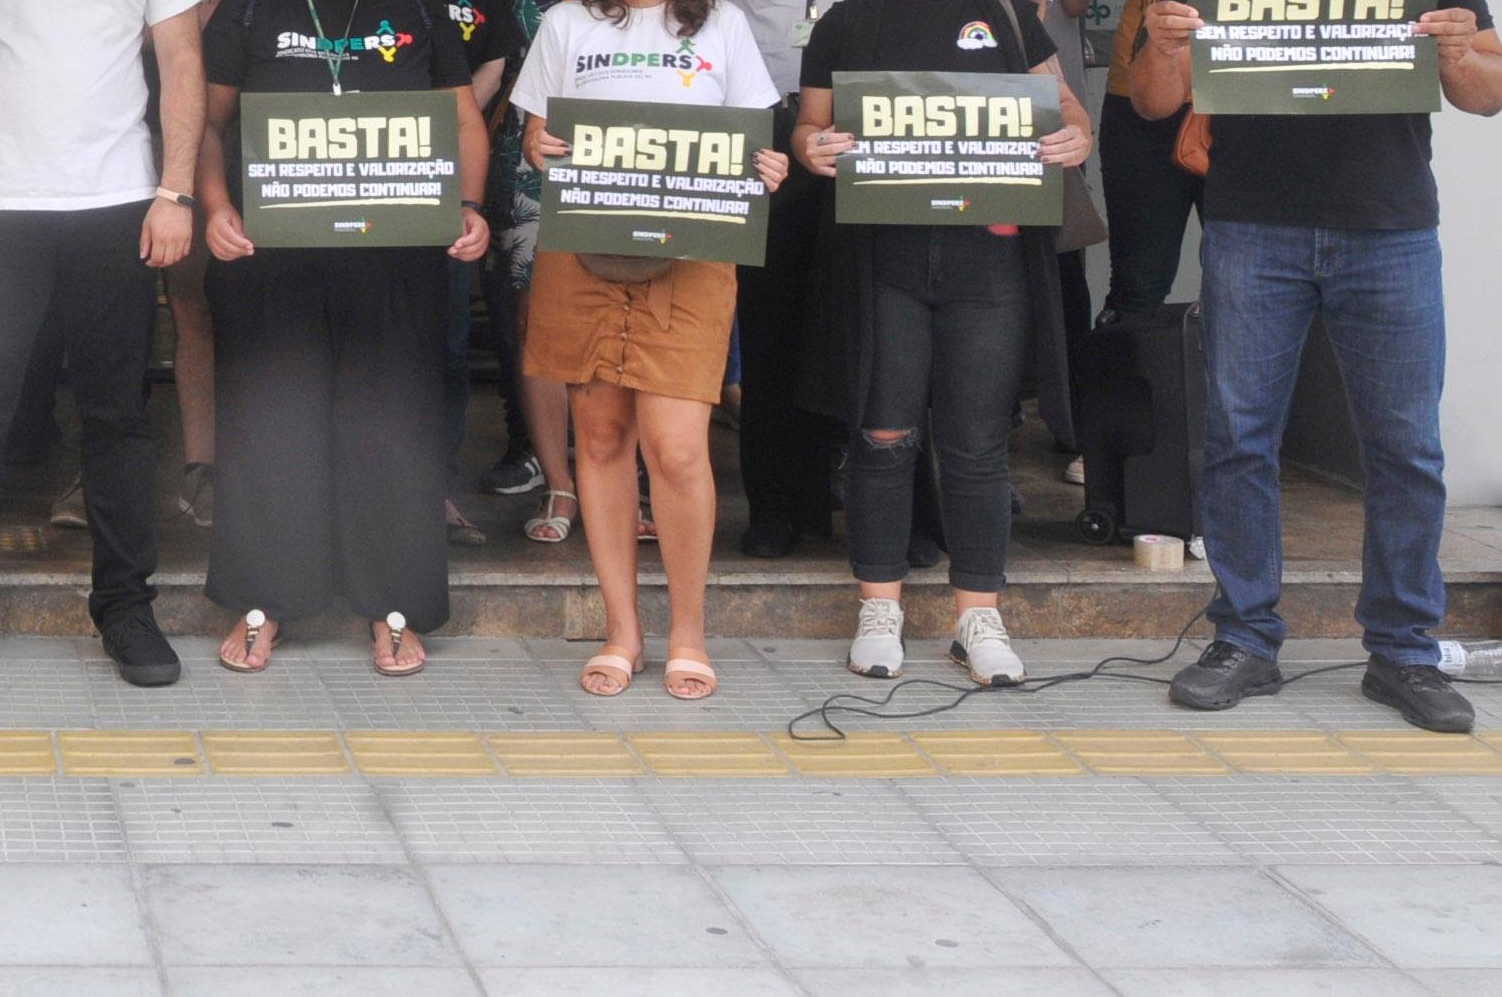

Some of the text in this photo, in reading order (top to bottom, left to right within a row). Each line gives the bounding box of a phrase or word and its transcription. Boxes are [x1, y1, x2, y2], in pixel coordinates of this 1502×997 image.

[1196, 26, 1226, 39] SEM
[1230, 25, 1301, 40] RESPEITO
[1211, 44, 1415, 61] NÃO PODEMOS CONTINUAR!
[576, 53, 692, 73] SINDPERS
[862, 96, 1033, 137] BASTA!
[268, 117, 432, 159] BASTA!
[874, 141, 941, 154] RESPEITO
[572, 124, 745, 176] BASTA!
[248, 163, 275, 177] SEM
[279, 163, 343, 177] RESPEITO
[359, 159, 454, 178] VALORIZAÇÃO
[856, 158, 1043, 175] NÃO PODEMOS CONTINUAR!
[262, 182, 441, 197] NÃO PODEMOS CONTINUAR!
[549, 168, 577, 182] SEM
[581, 170, 648, 187] RESPEITO
[666, 176, 764, 197] VALORIZAÇÃO
[561, 187, 749, 214] NÃO PODEMOS CONTINUAR!
